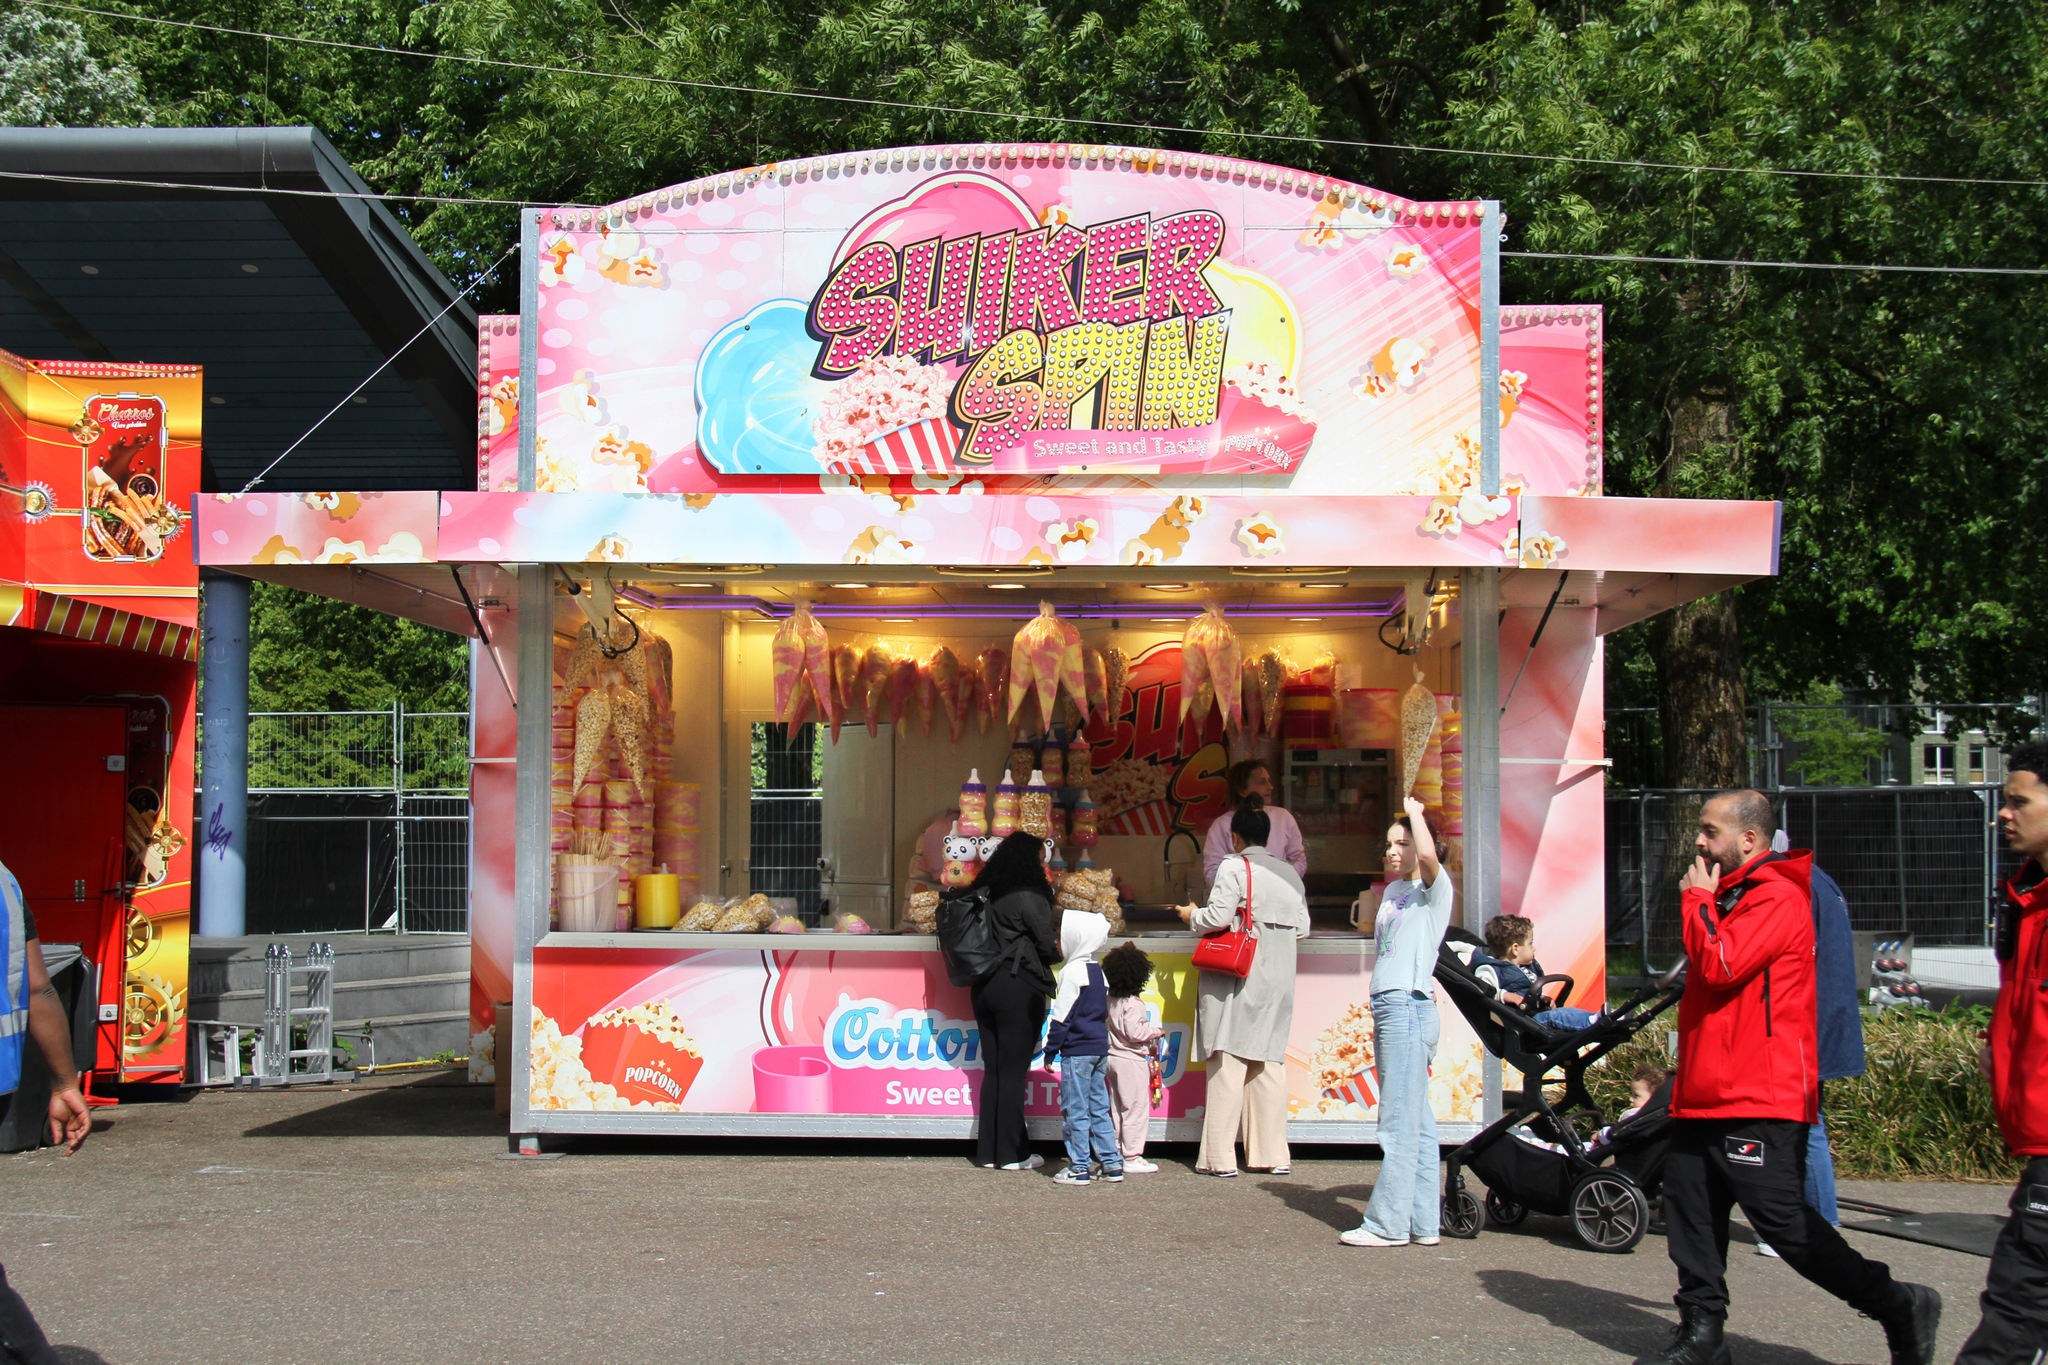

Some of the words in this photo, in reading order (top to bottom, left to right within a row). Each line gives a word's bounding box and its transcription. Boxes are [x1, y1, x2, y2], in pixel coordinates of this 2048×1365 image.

[811, 210, 1226, 377] SUIKER
[955, 308, 1233, 463] SPIN
[97, 402, 155, 423] Churros
[1033, 438, 1101, 458] Sweet
[1105, 436, 1147, 456] and
[1150, 436, 1209, 458] Tasty
[1223, 434, 1294, 472] POPCORN
[623, 1066, 683, 1101] POPCORN
[885, 1080, 973, 1106] Sweet
